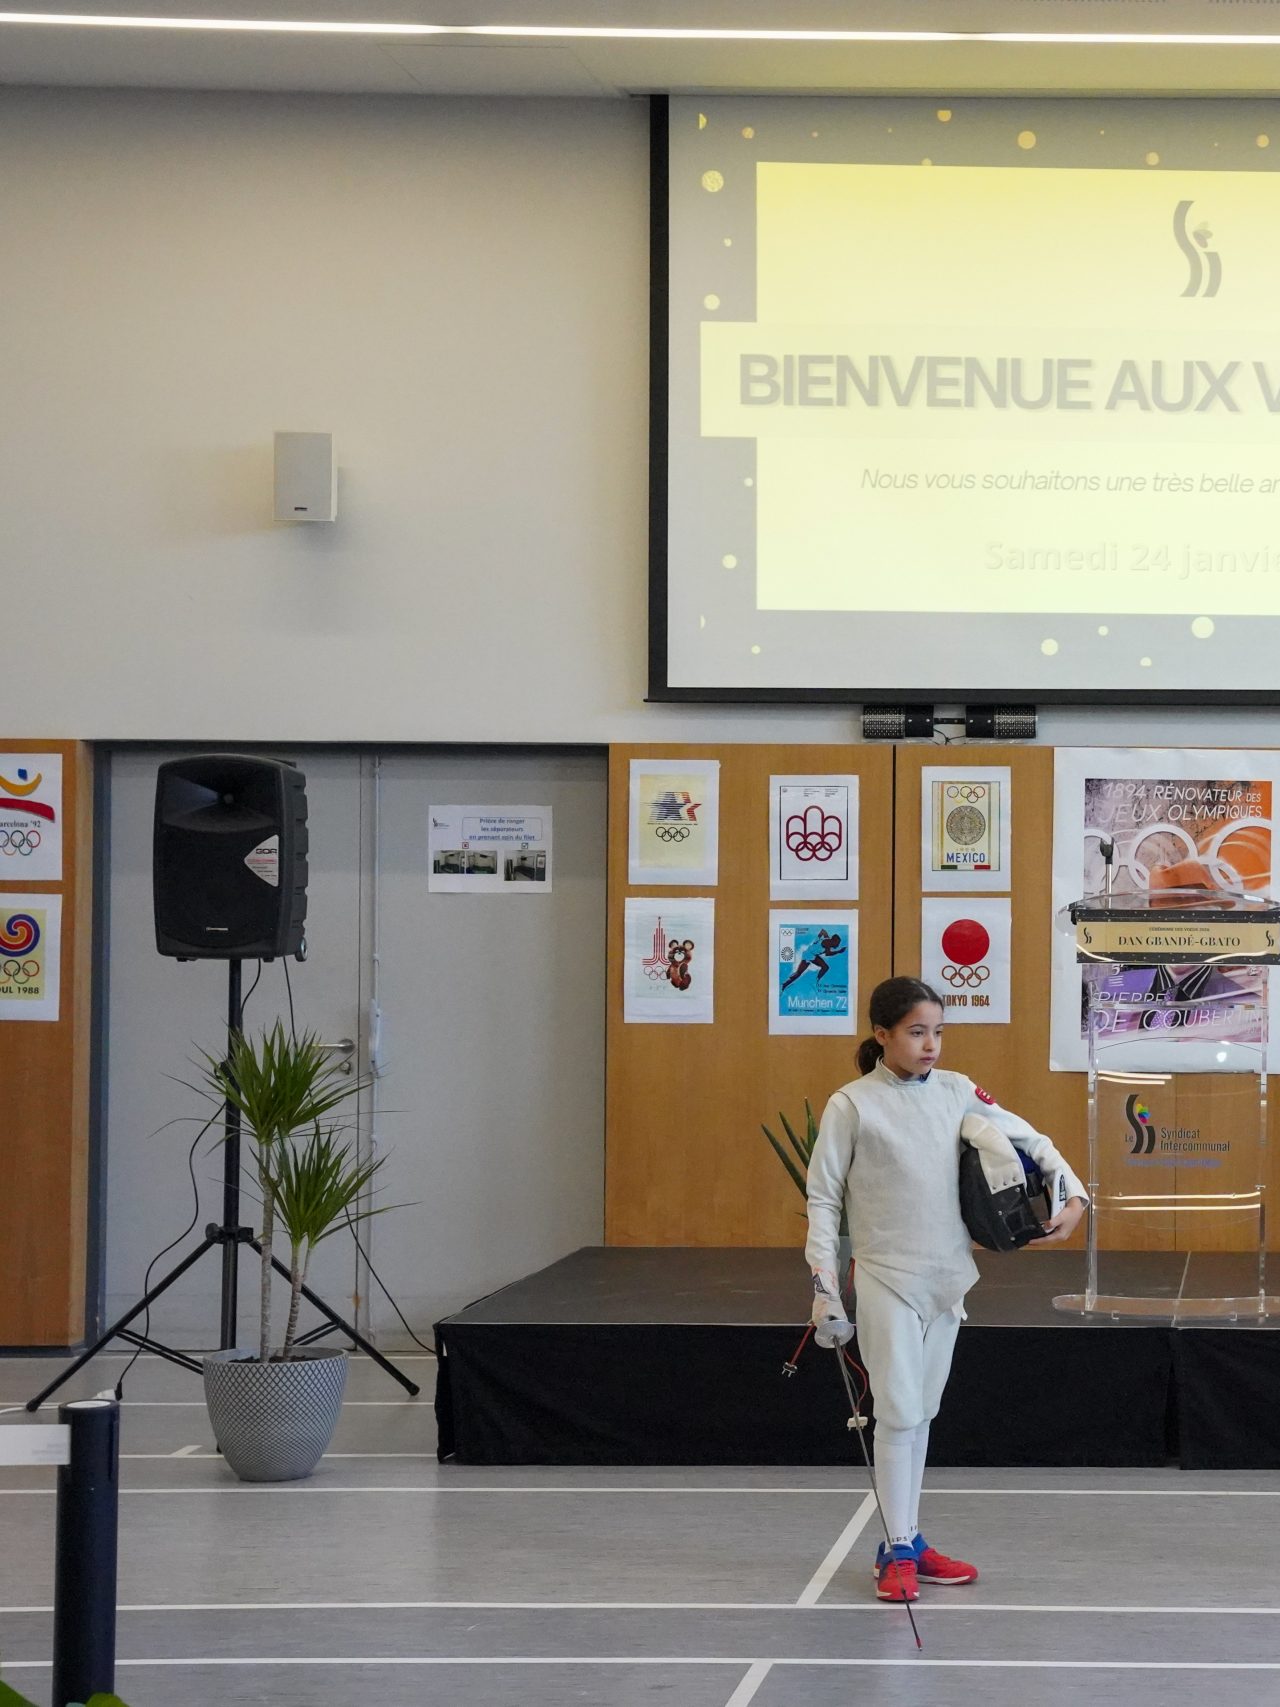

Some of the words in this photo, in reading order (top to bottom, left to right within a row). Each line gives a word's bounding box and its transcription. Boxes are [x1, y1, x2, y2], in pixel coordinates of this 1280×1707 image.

[739, 354, 1093, 410] BIENVENUE
[1104, 359, 1243, 412] AUX
[861, 469, 919, 489] Nous
[925, 473, 977, 490] vous
[981, 470, 1101, 491] souhaitons
[1106, 475, 1147, 492] une
[1152, 471, 1194, 493] très
[1199, 473, 1255, 494] belle
[985, 541, 1119, 571] Samedi
[1129, 544, 1173, 571] 24
[1104, 782, 1147, 799] 1894
[1153, 783, 1242, 802] RÉNOVATEUR
[1245, 792, 1262, 803] DES
[1099, 804, 1162, 823] JEUX
[1167, 804, 1263, 822] OLYMPIQUES
[946, 852, 986, 863] MEXICO
[1118, 936, 1143, 946] DAN
[1146, 934, 1241, 947] GBANDÉ-GBATO
[17, 986, 40, 995] 1988
[836, 995, 847, 1009] 72
[942, 995, 968, 1007] TOKYO
[971, 995, 990, 1007] 1964
[1160, 1127, 1201, 1140] Syndicat
[1160, 1140, 1230, 1152] Intercommunal
